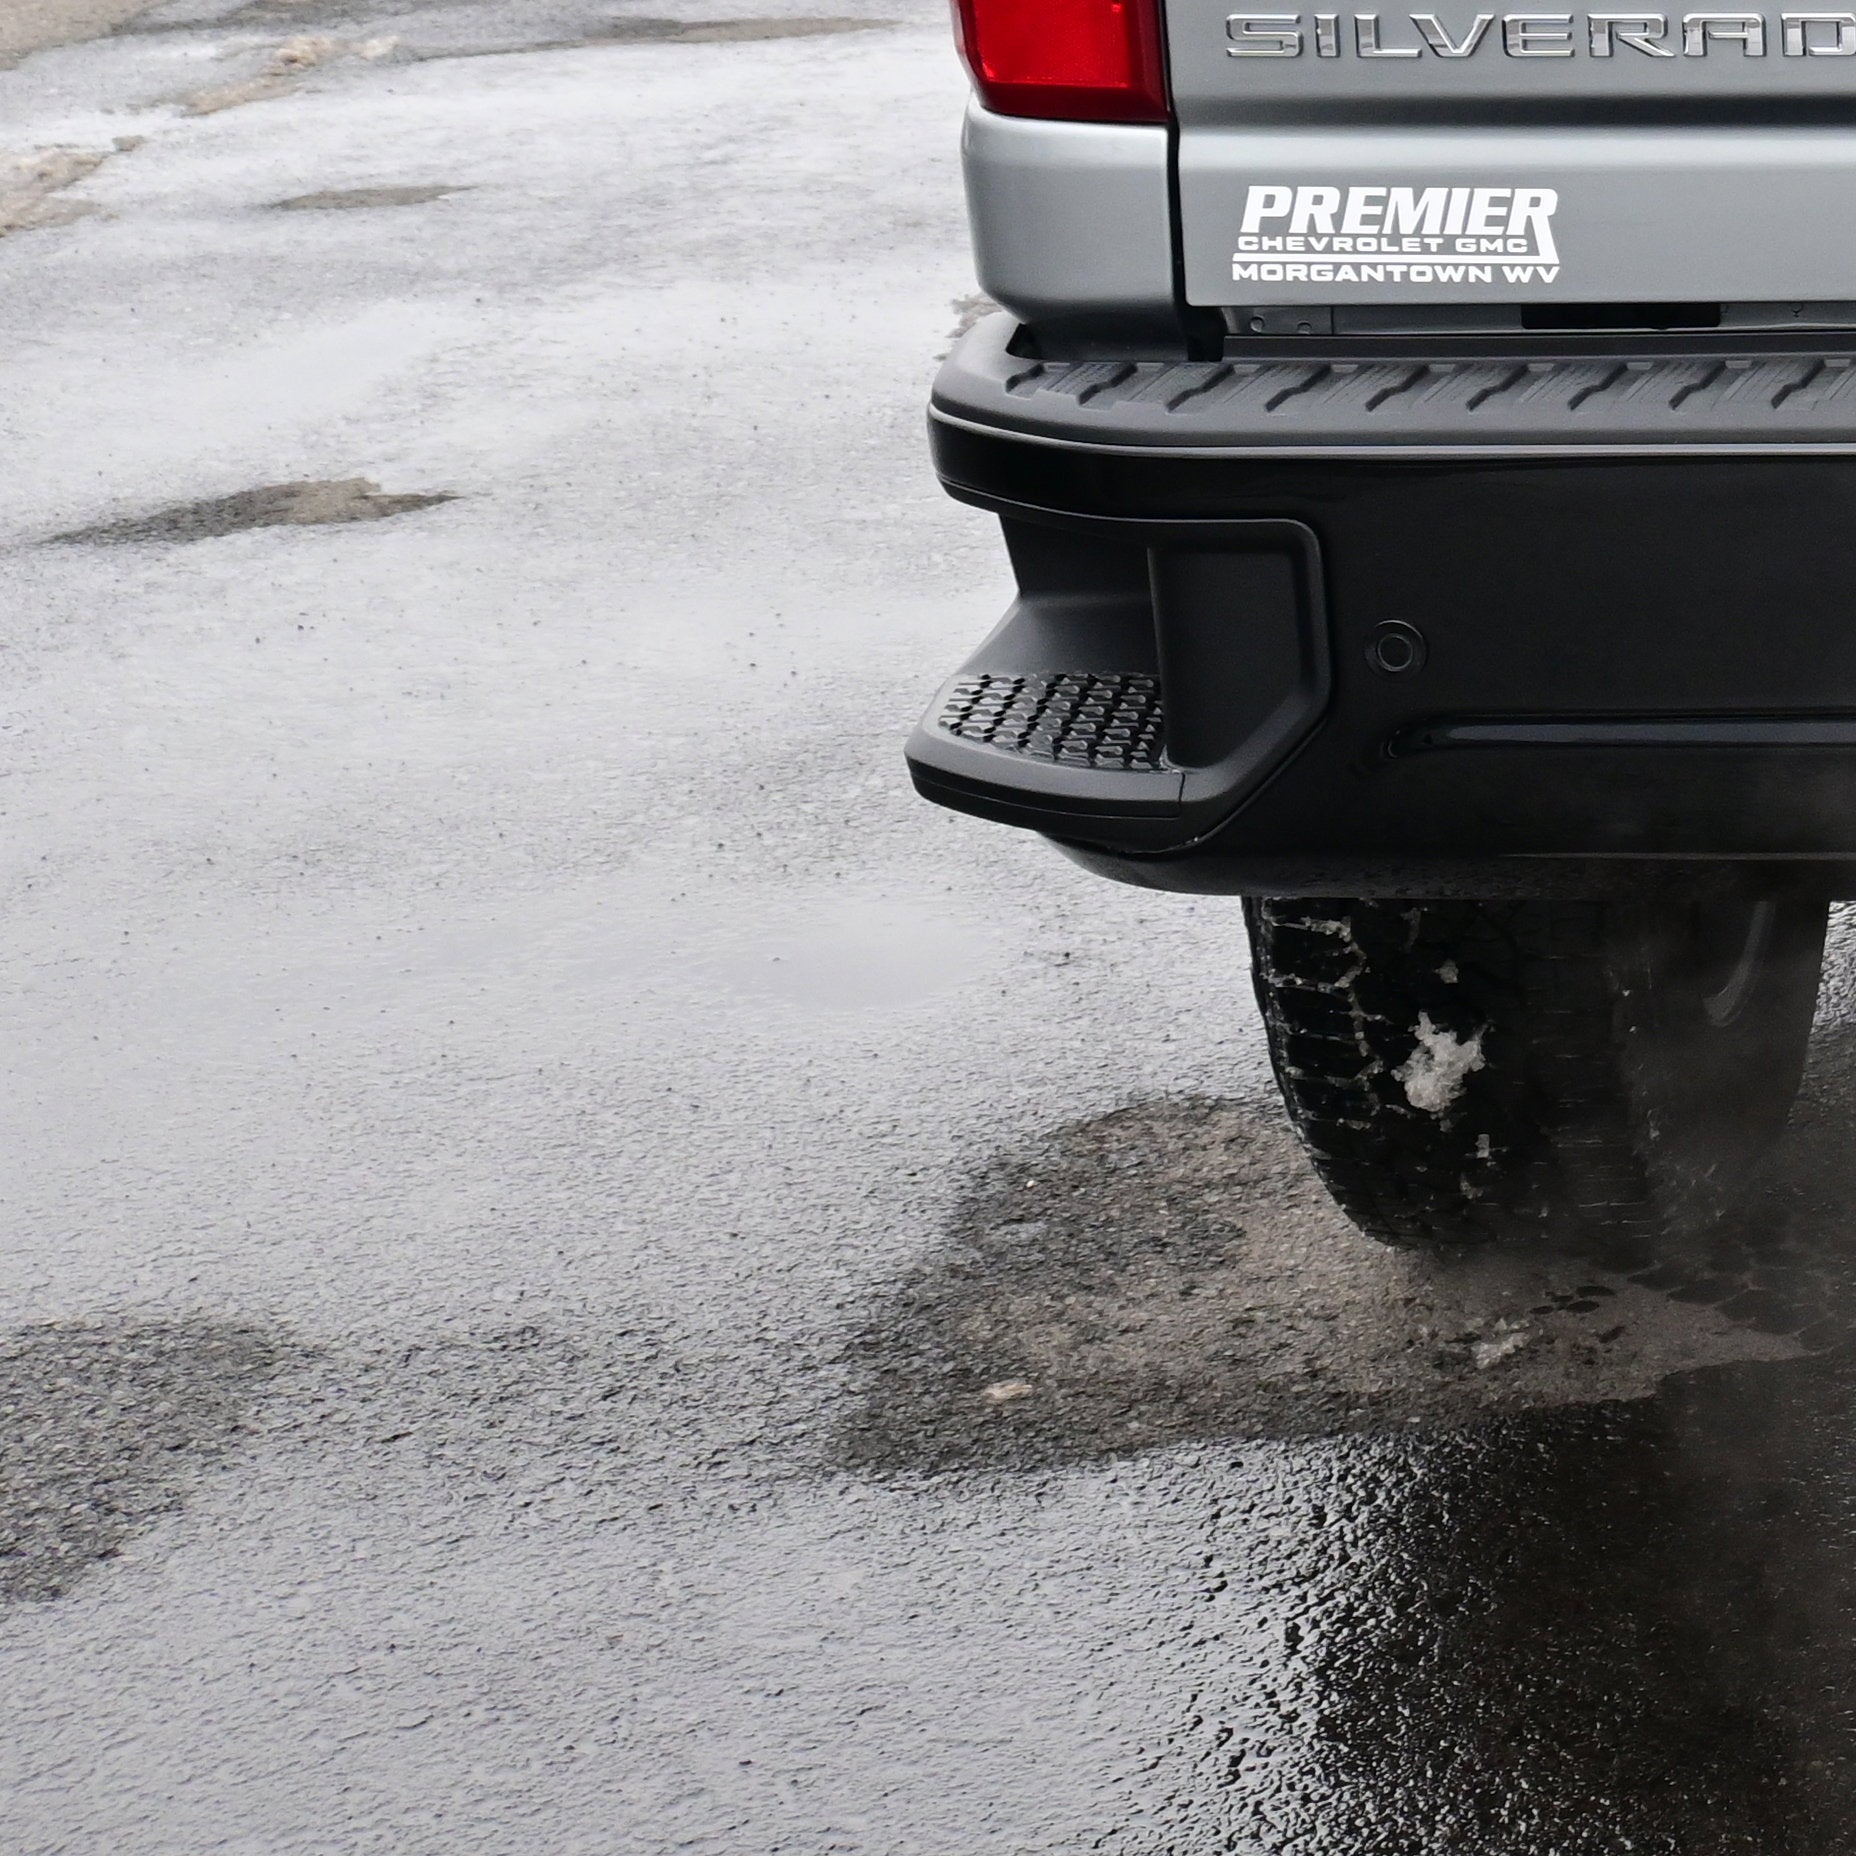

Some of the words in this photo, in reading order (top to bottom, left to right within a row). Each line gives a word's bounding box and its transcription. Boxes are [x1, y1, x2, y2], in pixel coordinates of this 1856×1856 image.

[1240, 185, 1560, 256] PREMIER
[1237, 236, 1444, 253] CHEVROLET
[1455, 236, 1528, 254] GMC
[1232, 263, 1489, 283] MORGANTOWN
[1502, 264, 1560, 283] WV
